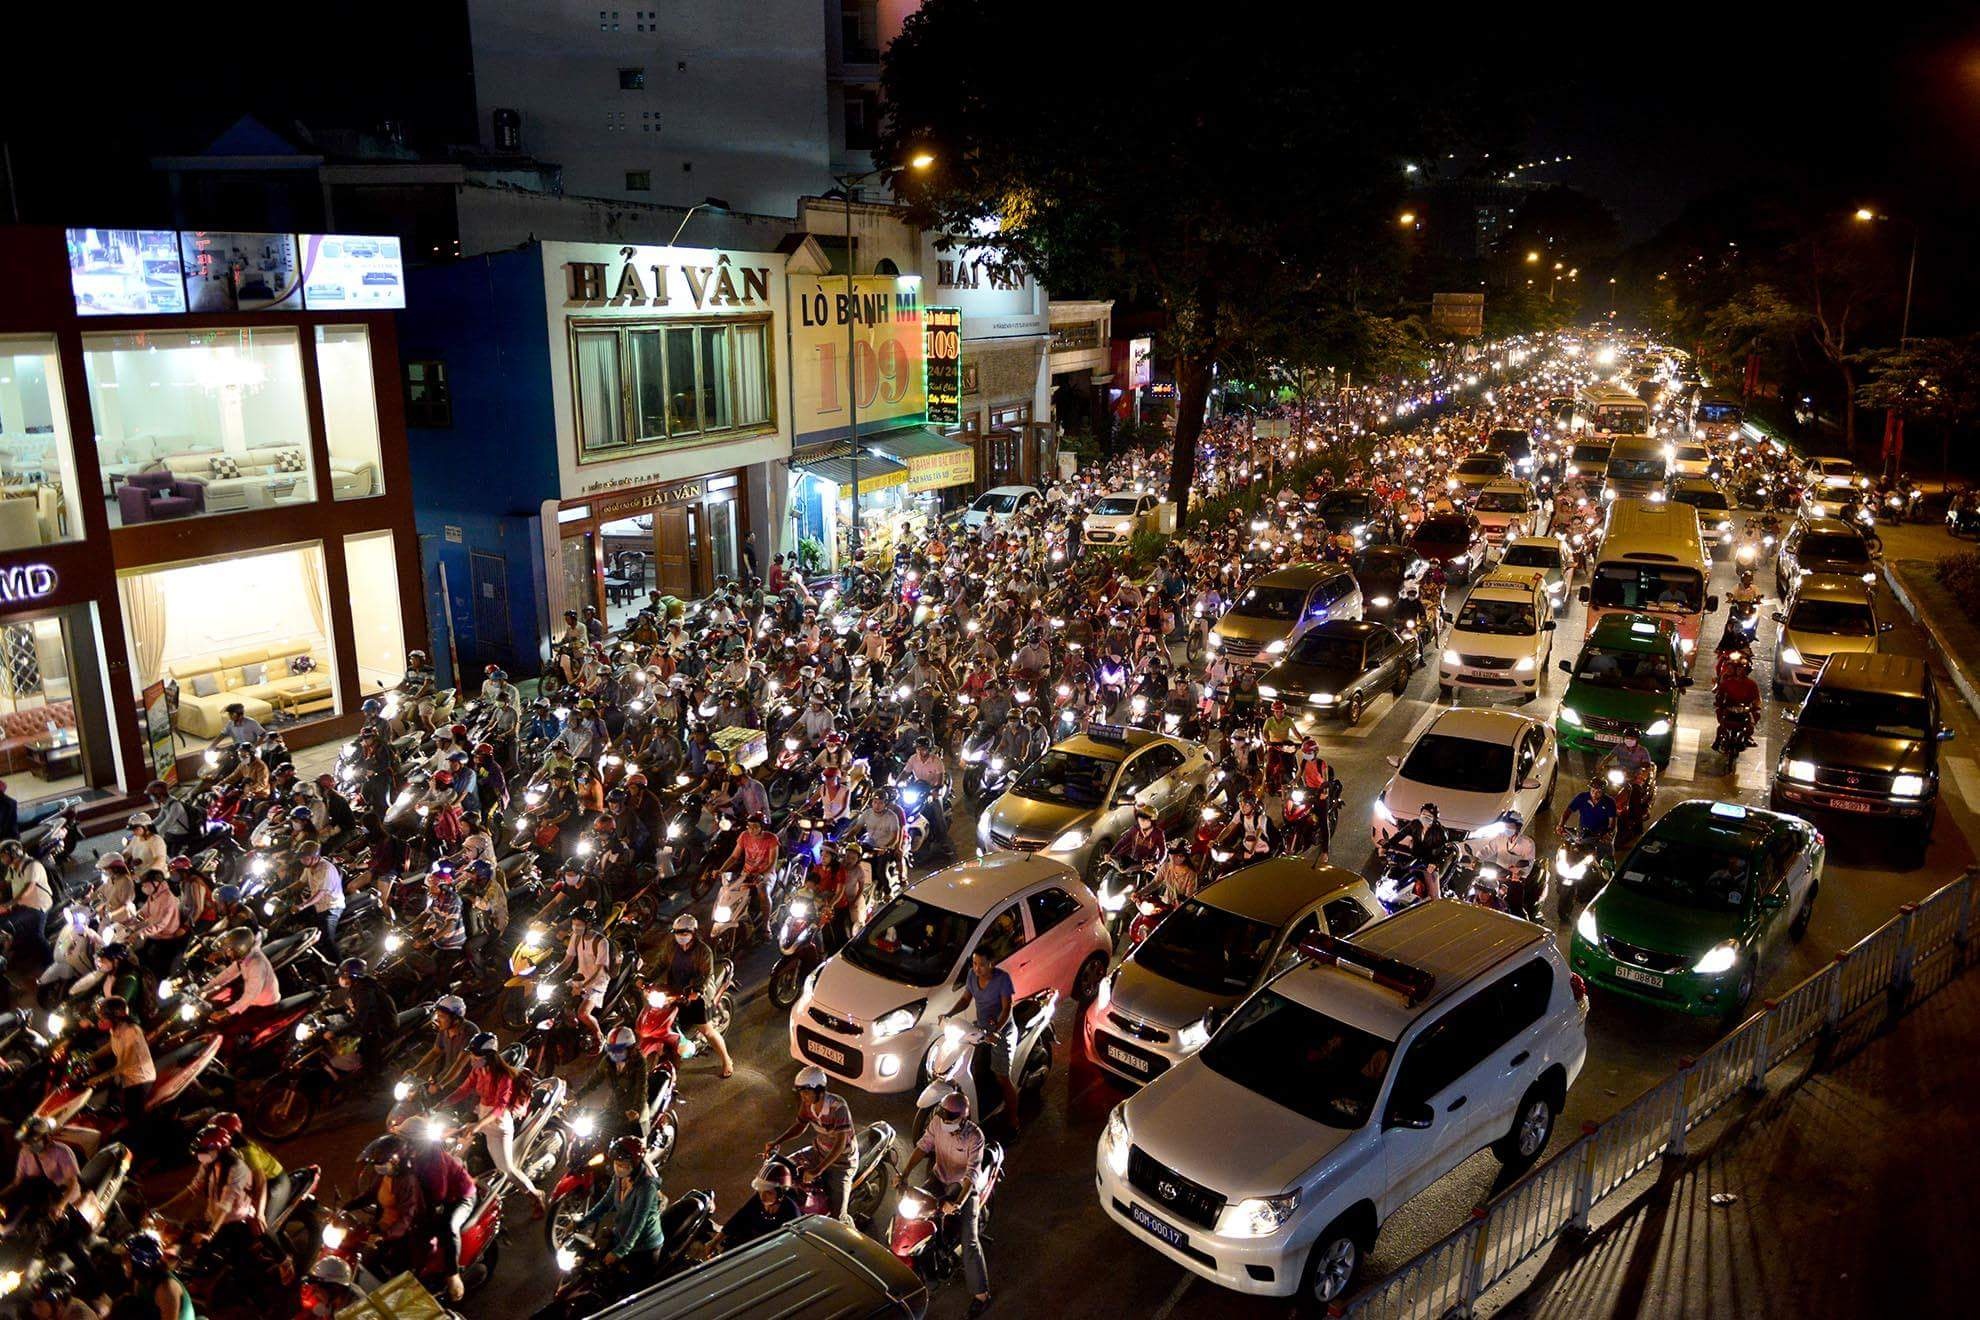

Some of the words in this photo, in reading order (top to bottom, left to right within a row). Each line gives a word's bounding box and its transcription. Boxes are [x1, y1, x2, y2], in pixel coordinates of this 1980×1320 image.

[562, 246, 670, 308] HẢI
[680, 252, 771, 310] VÂN
[801, 284, 829, 327] LÒ
[836, 285, 889, 326] BÁNH
[895, 285, 917, 322] MÌ
[926, 330, 959, 359] 109
[814, 340, 911, 415] 109
[672, 485, 700, 500] VÂN
